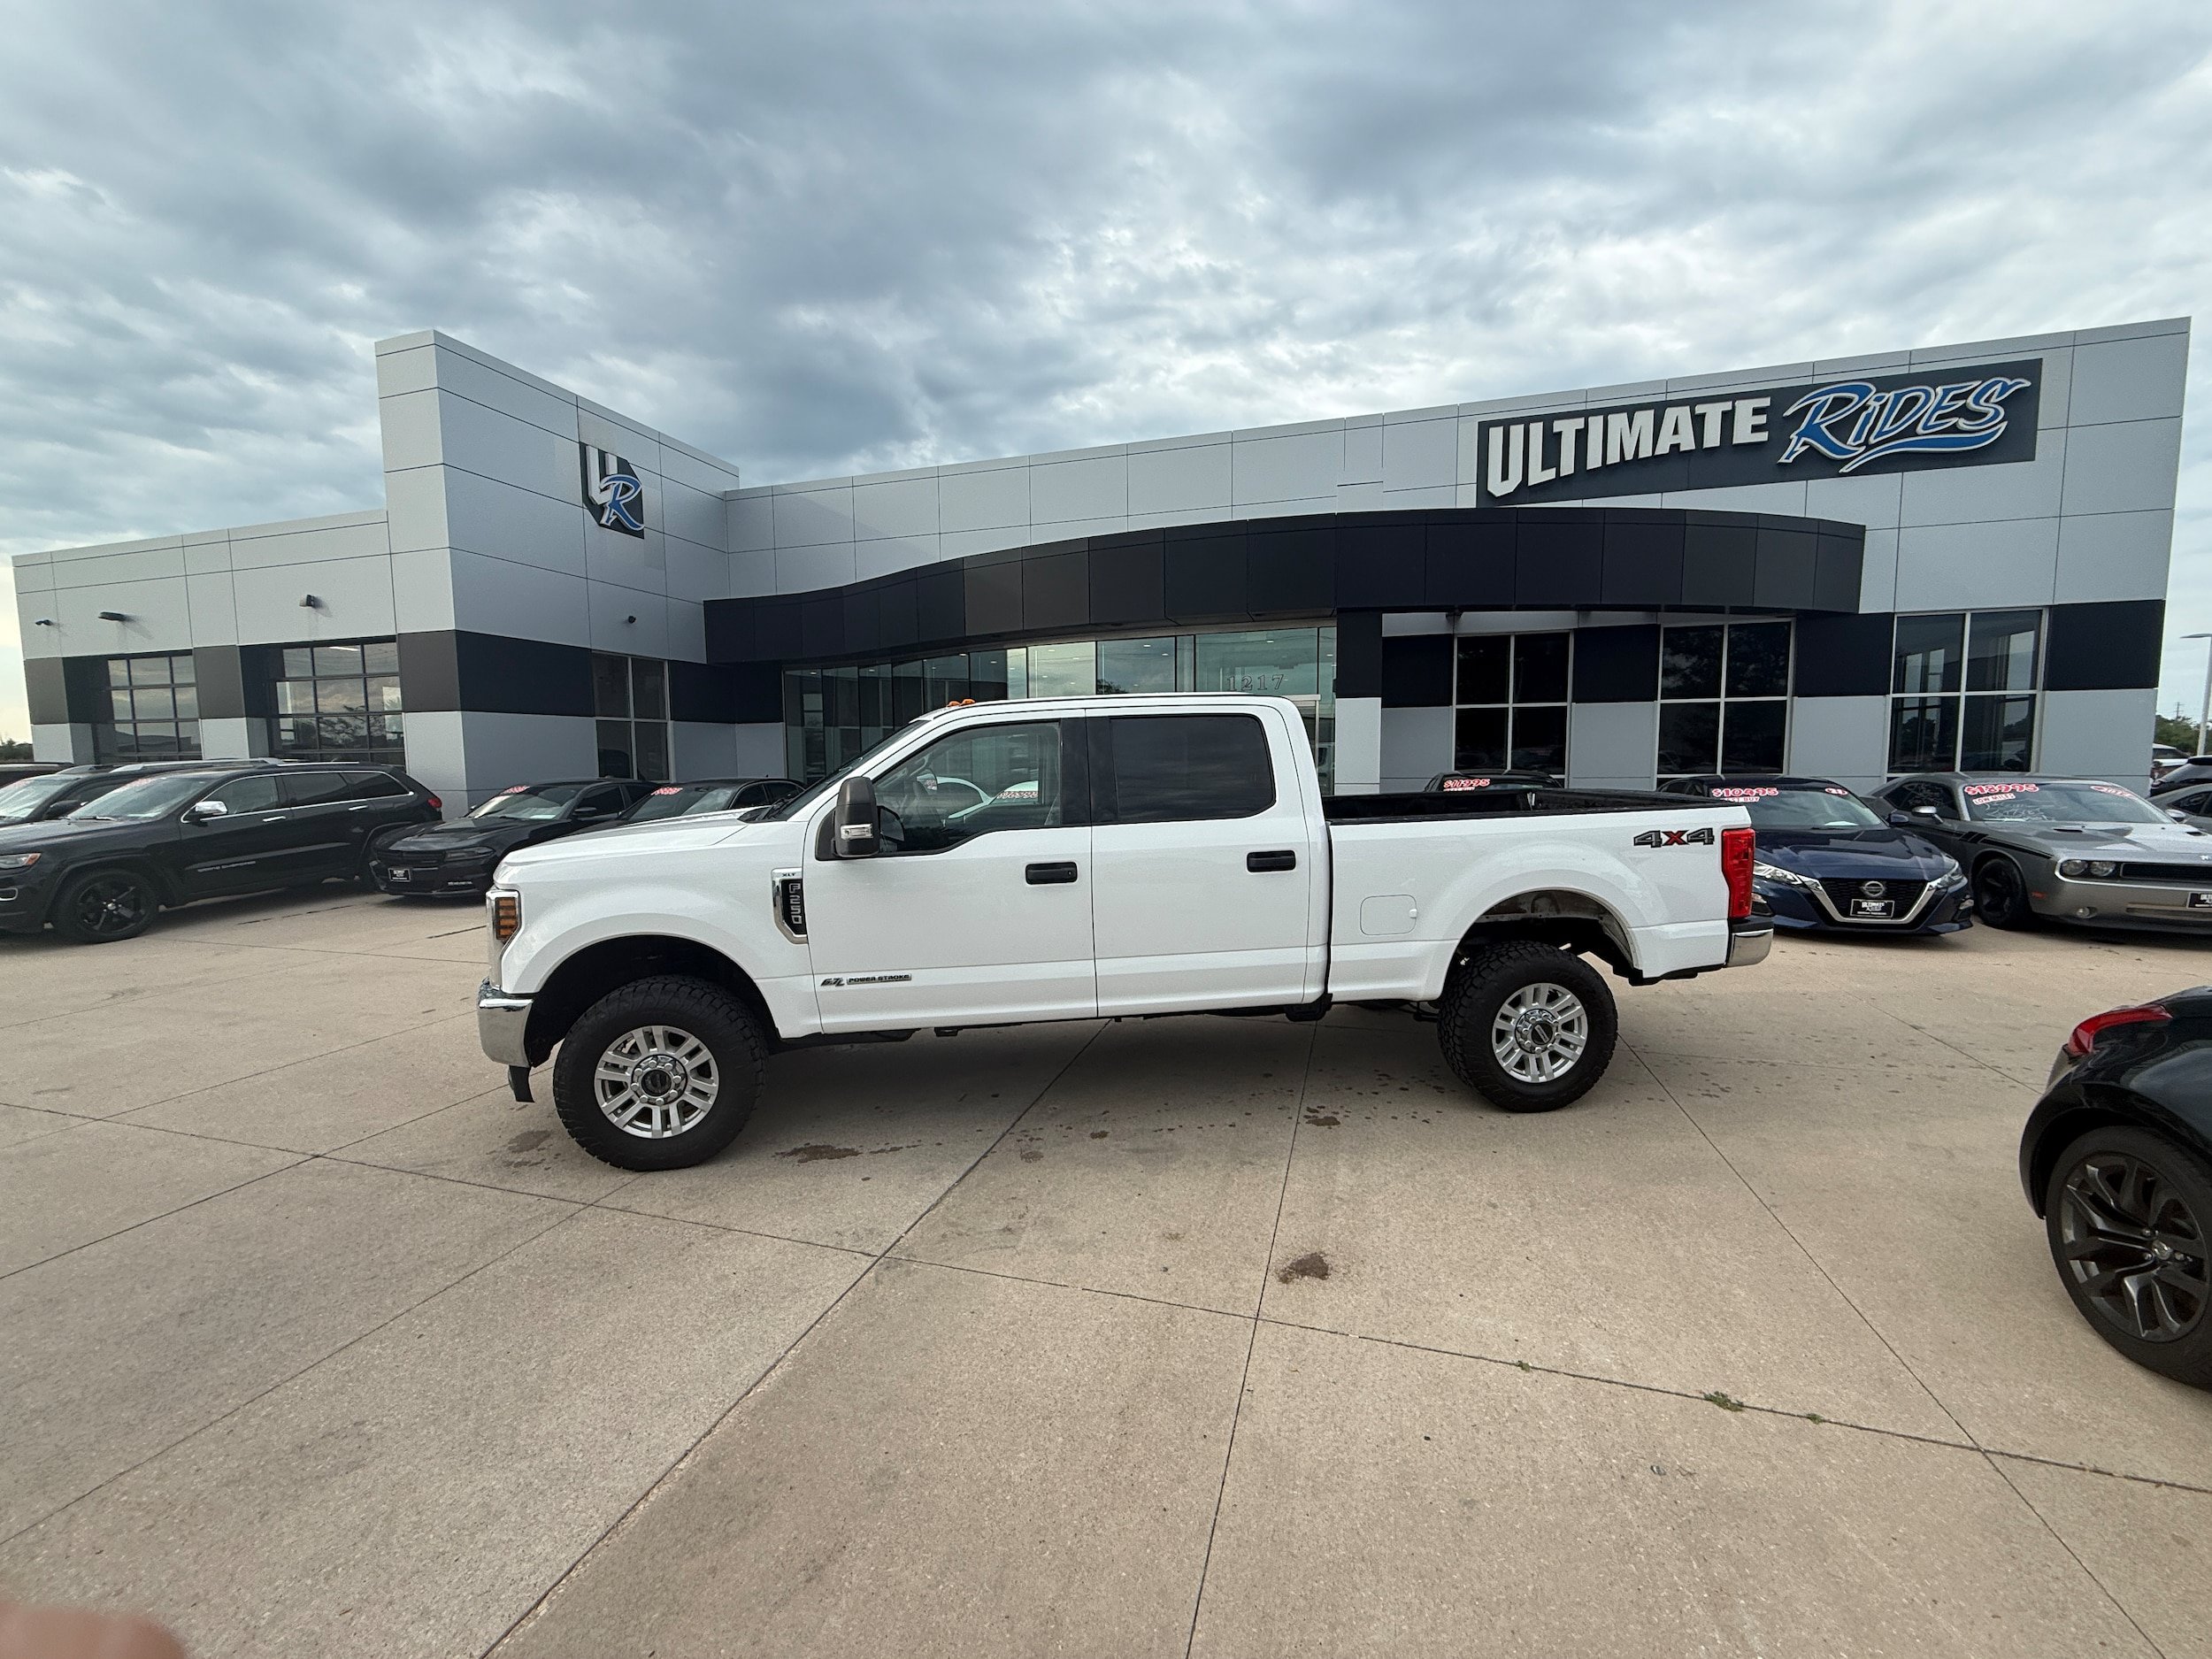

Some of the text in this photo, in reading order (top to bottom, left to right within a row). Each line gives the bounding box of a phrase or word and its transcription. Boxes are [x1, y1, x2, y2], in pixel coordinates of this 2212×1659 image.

[1486, 396, 1770, 497] ULTIMATE
[1226, 673, 1285, 692] 1217
[1633, 827, 1715, 849] 4X4
[789, 883, 803, 924] F250
